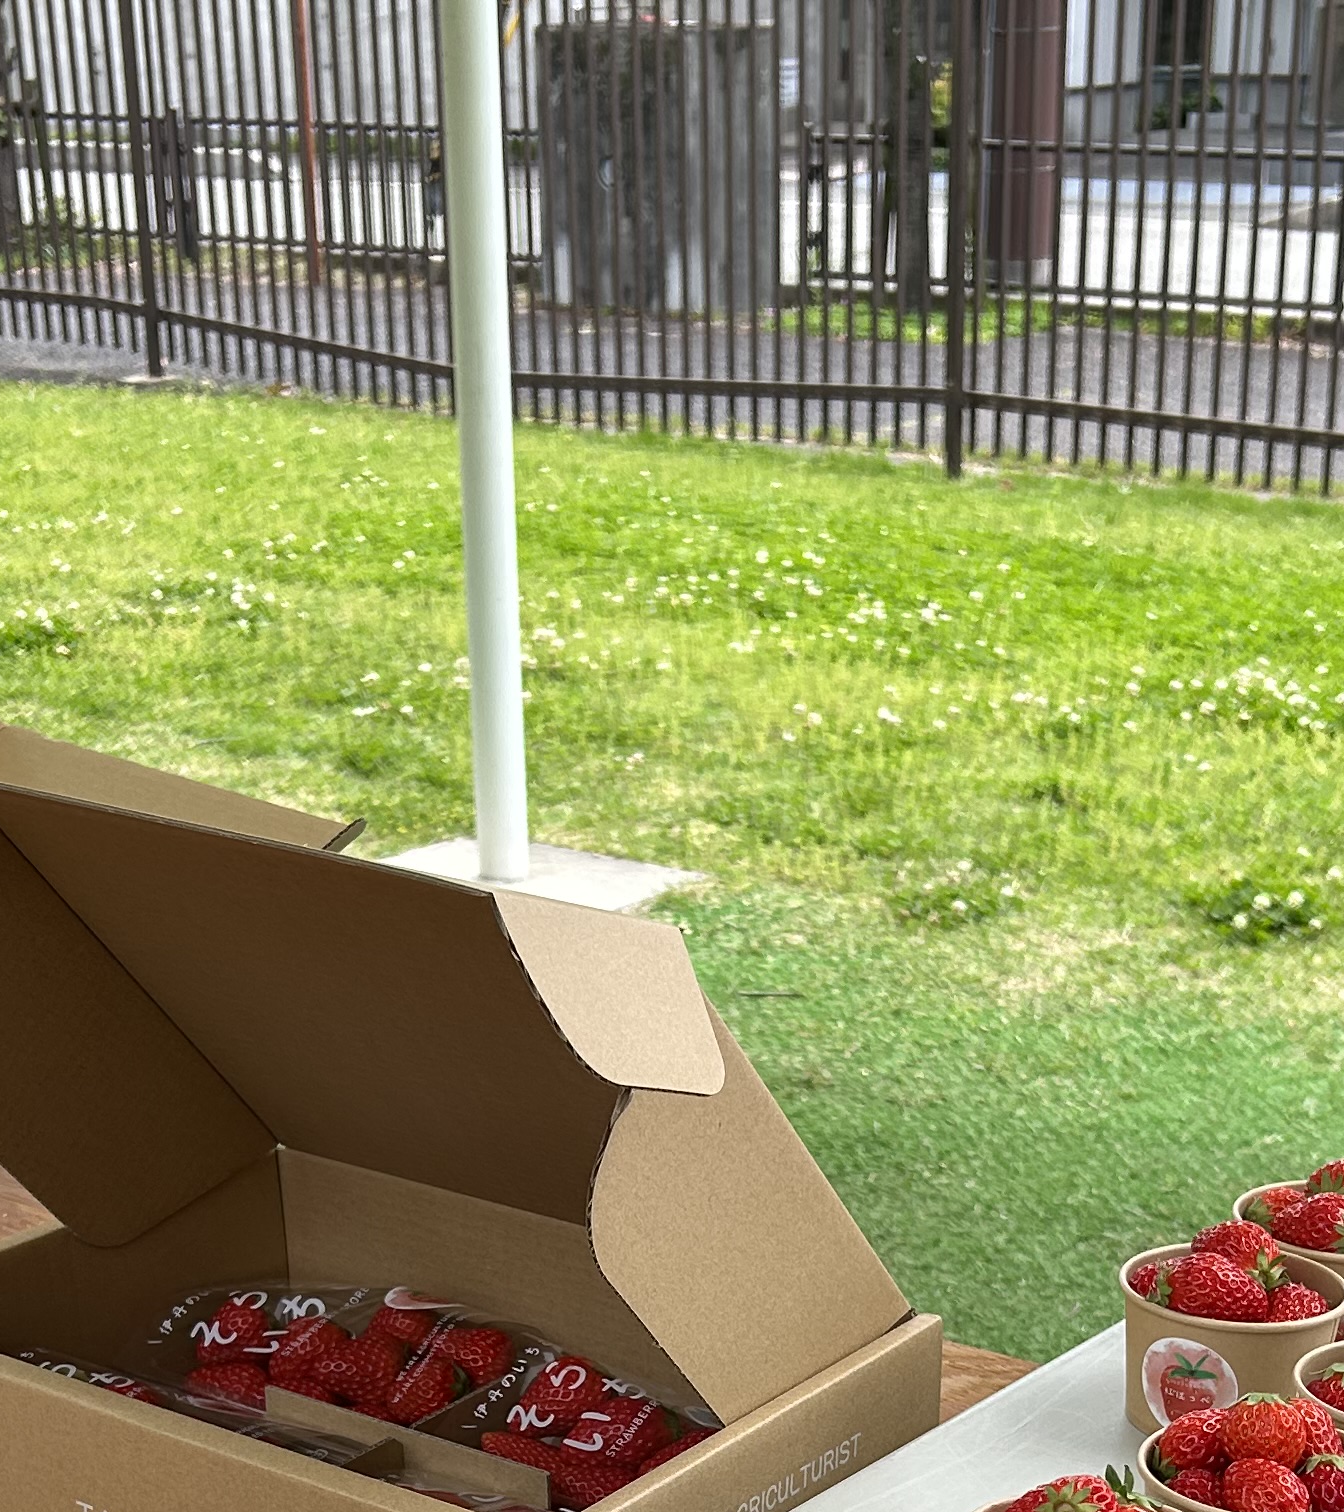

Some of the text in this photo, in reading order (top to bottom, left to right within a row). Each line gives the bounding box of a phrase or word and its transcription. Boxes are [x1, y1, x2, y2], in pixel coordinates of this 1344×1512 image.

[190, 1290, 268, 1347] そら
[506, 1361, 587, 1432] そら
[563, 1377, 646, 1451] いち
